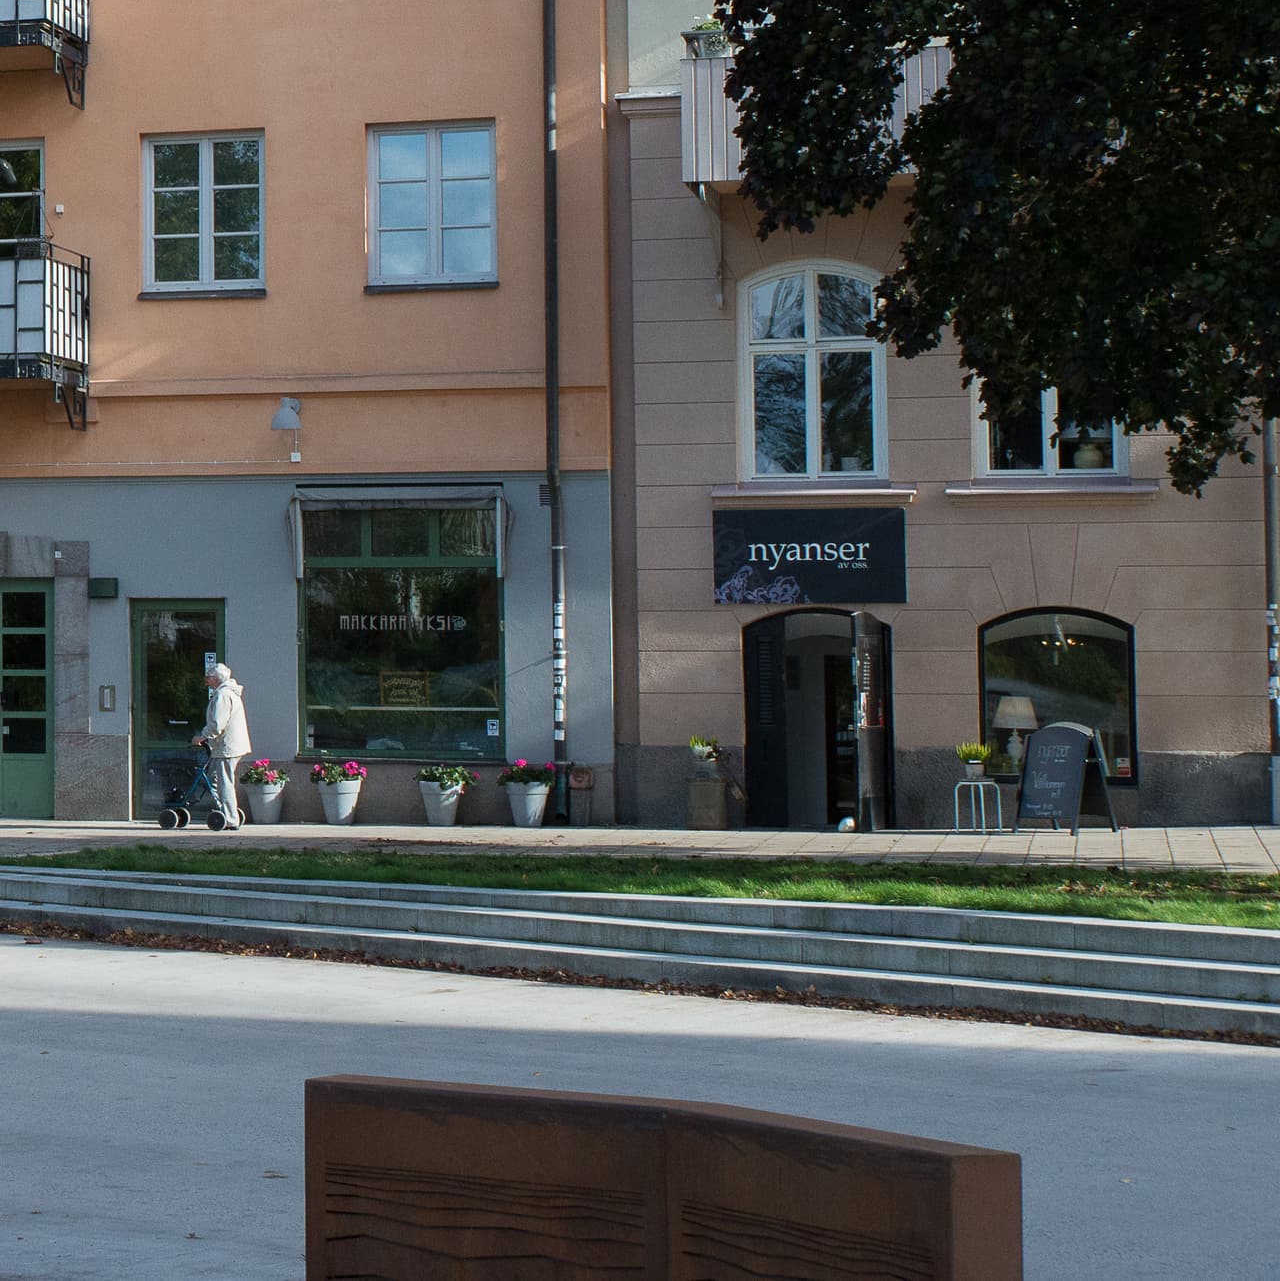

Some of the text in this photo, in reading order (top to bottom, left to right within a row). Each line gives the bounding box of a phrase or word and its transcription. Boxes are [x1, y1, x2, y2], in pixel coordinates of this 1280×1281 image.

[748, 541, 870, 571] nyanser
[837, 562, 850, 570] av
[339, 615, 407, 631] MAKKARA
